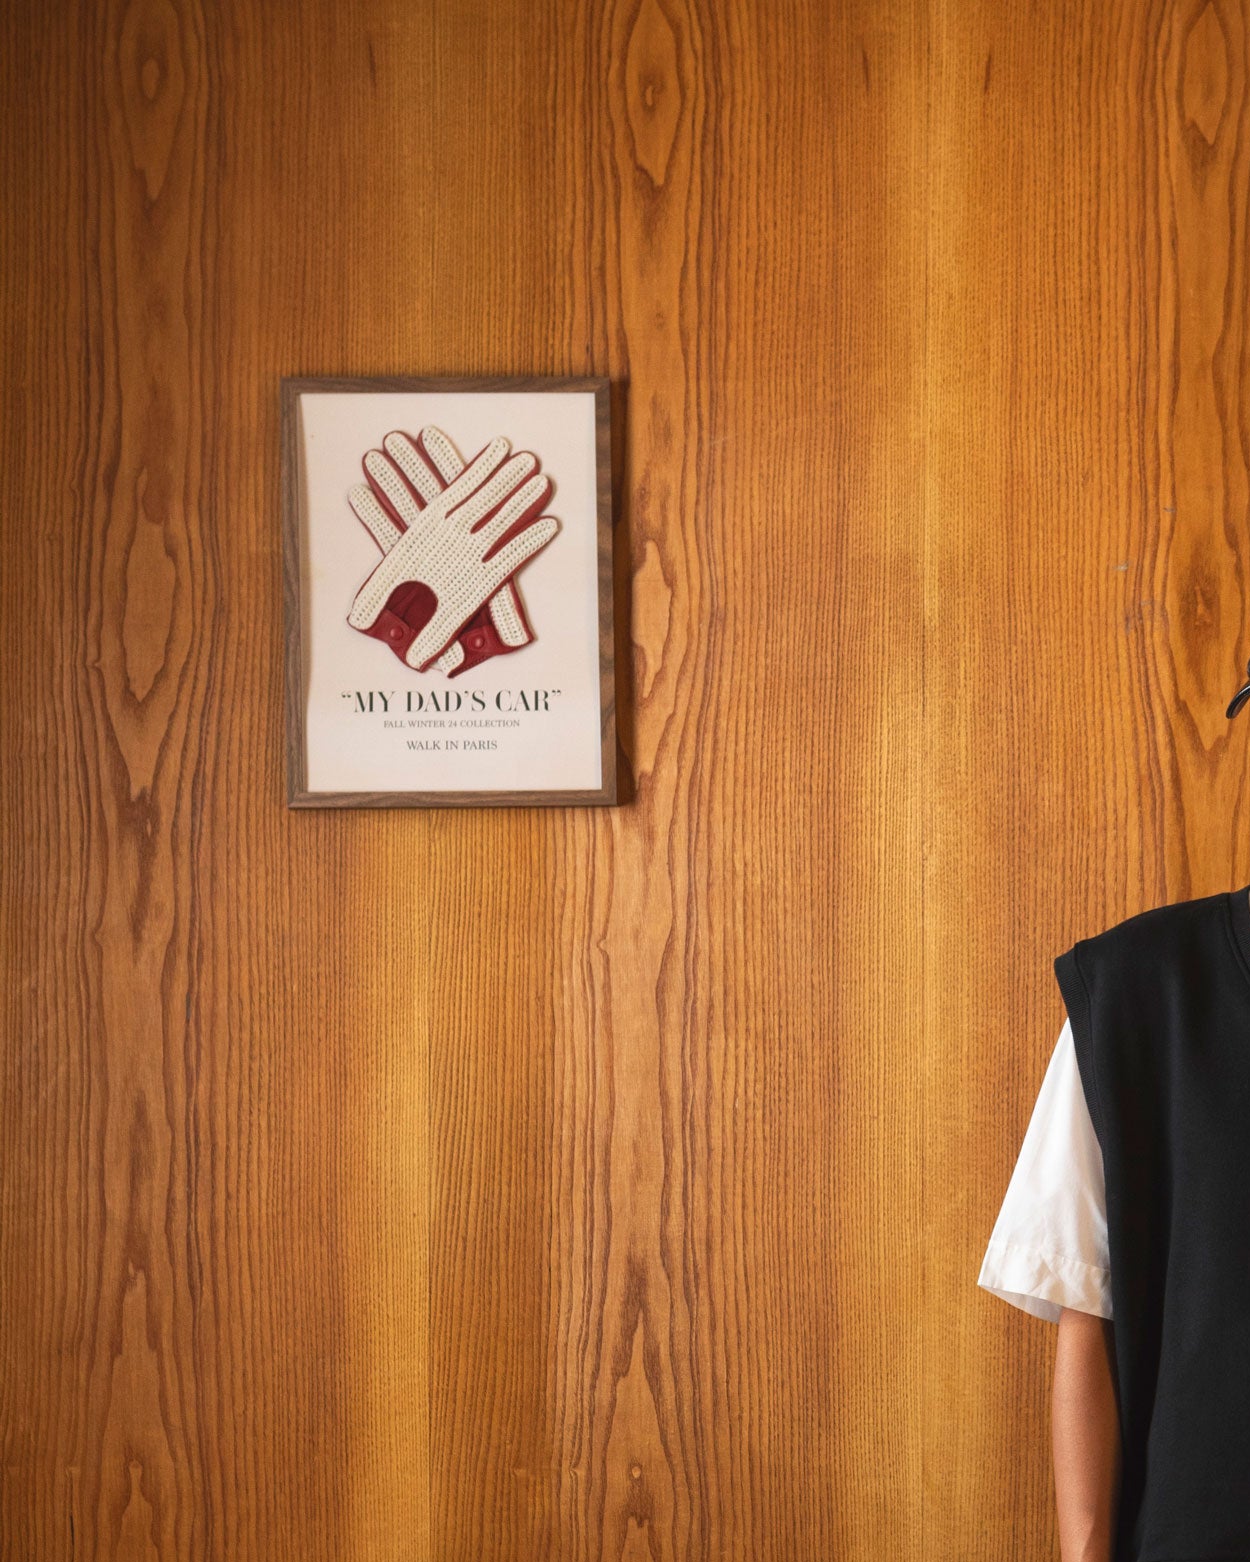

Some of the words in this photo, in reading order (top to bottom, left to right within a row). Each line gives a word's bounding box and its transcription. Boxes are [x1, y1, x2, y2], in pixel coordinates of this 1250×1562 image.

[383, 720, 406, 728] FALL
[408, 720, 445, 728] WINTER
[447, 720, 457, 728] 24
[459, 719, 520, 728] COLLECTION
[406, 740, 441, 751] WALK
[445, 740, 459, 750] IN
[463, 740, 498, 750] PARIS
